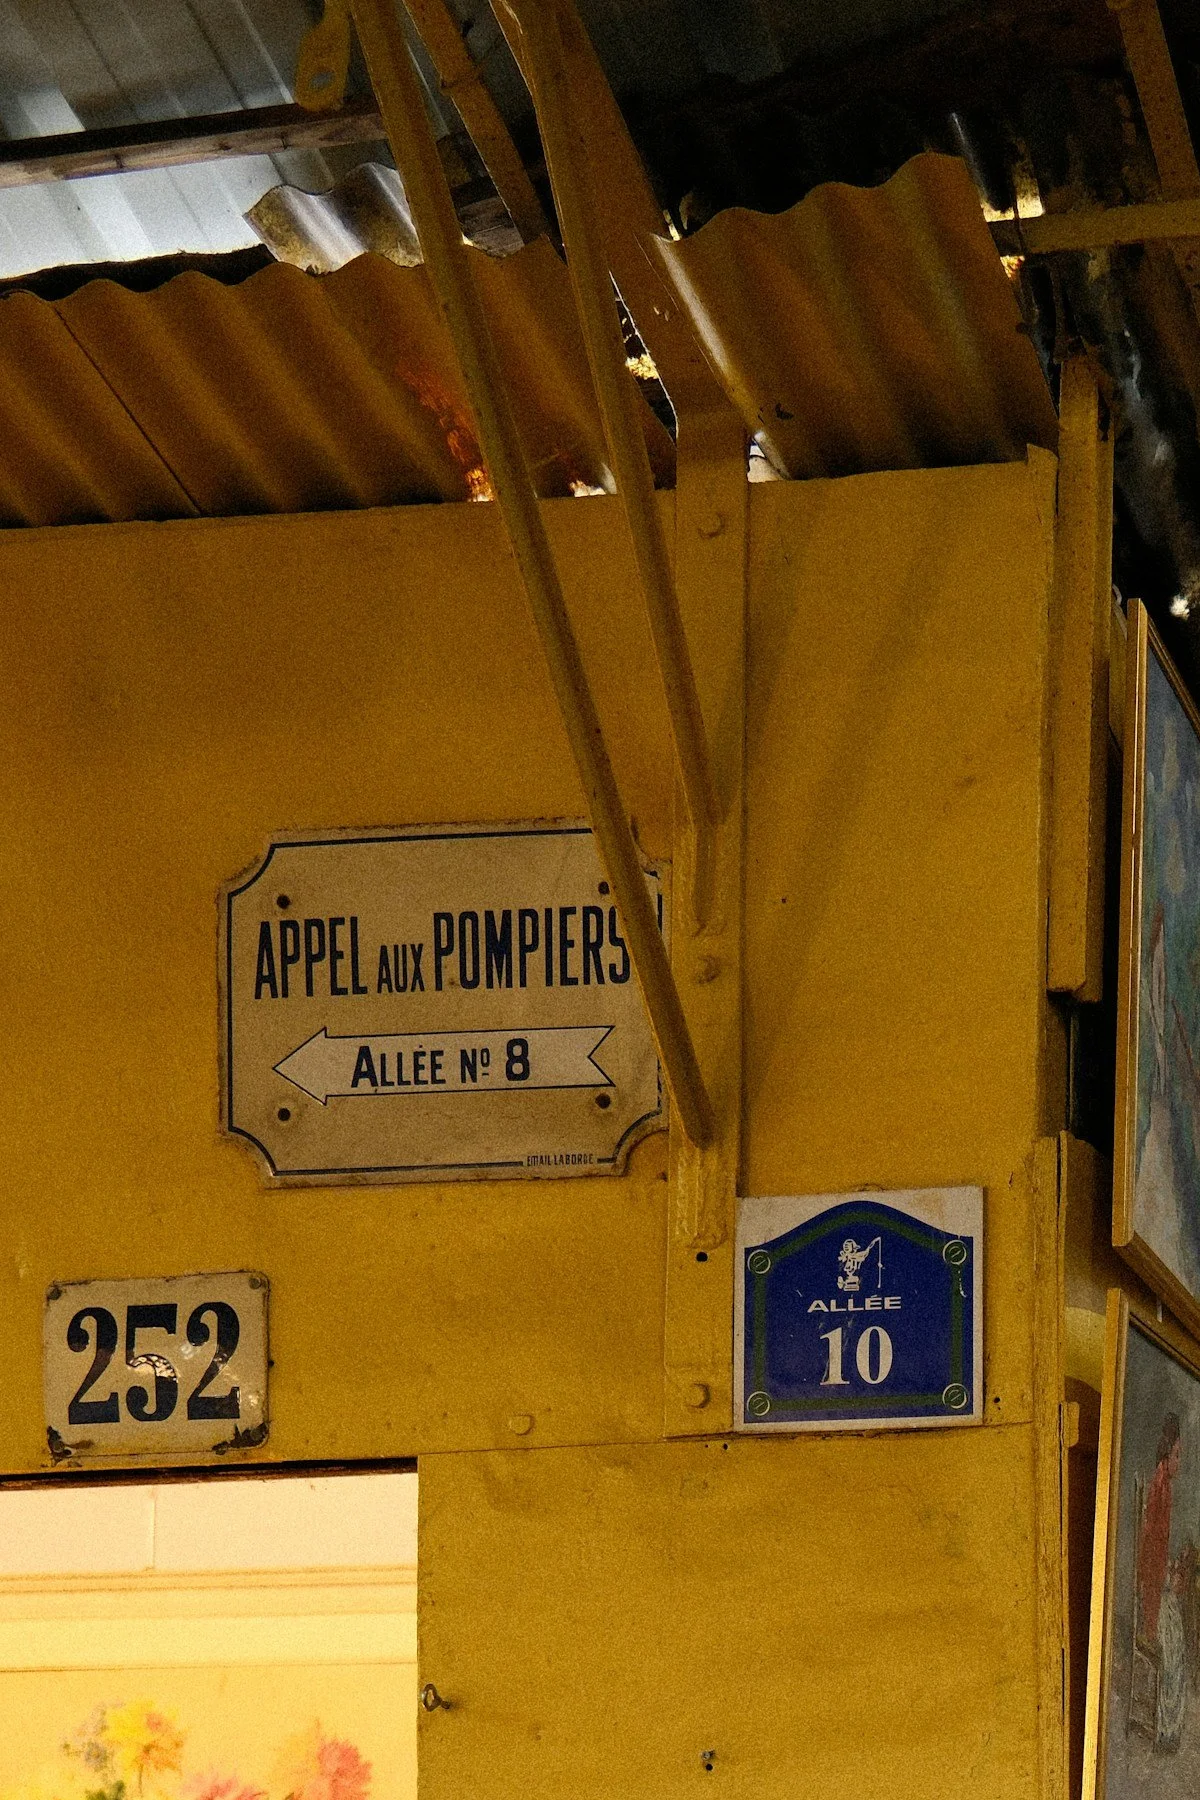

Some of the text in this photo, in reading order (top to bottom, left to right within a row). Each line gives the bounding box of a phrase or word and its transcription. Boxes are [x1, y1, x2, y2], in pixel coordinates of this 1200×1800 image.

[254, 904, 632, 1000] APPEL AUX POMPIERS
[504, 1037, 532, 1082] 8
[806, 1294, 902, 1313] ALLÉE
[66, 1301, 241, 1425] 252
[819, 1325, 894, 1386] 10
